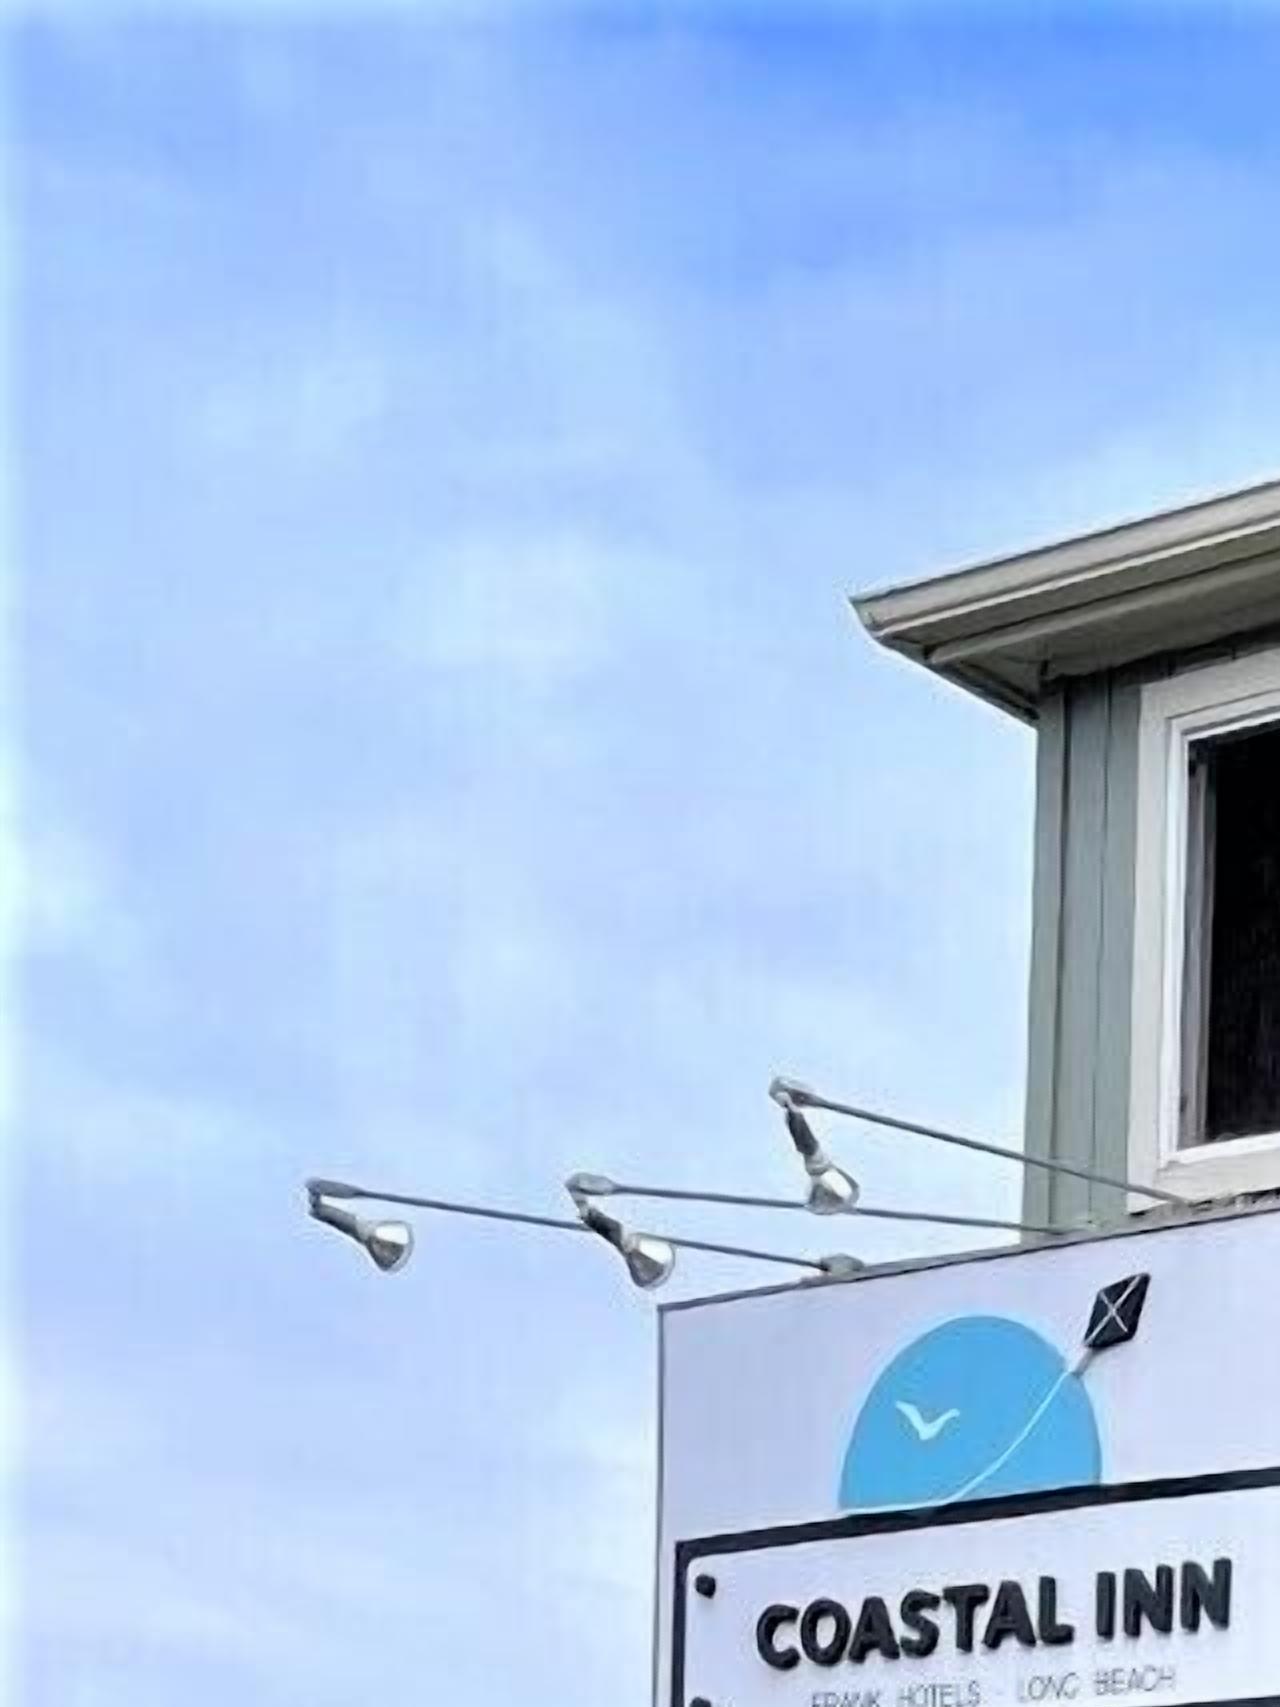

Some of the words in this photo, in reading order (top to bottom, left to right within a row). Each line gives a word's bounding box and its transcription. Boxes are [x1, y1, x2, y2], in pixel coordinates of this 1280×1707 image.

[756, 1575, 1075, 1671] COASTAL
[1096, 1557, 1233, 1641] INN
[1019, 1671, 1079, 1704] LONG
[1095, 1664, 1176, 1696] BEACH
